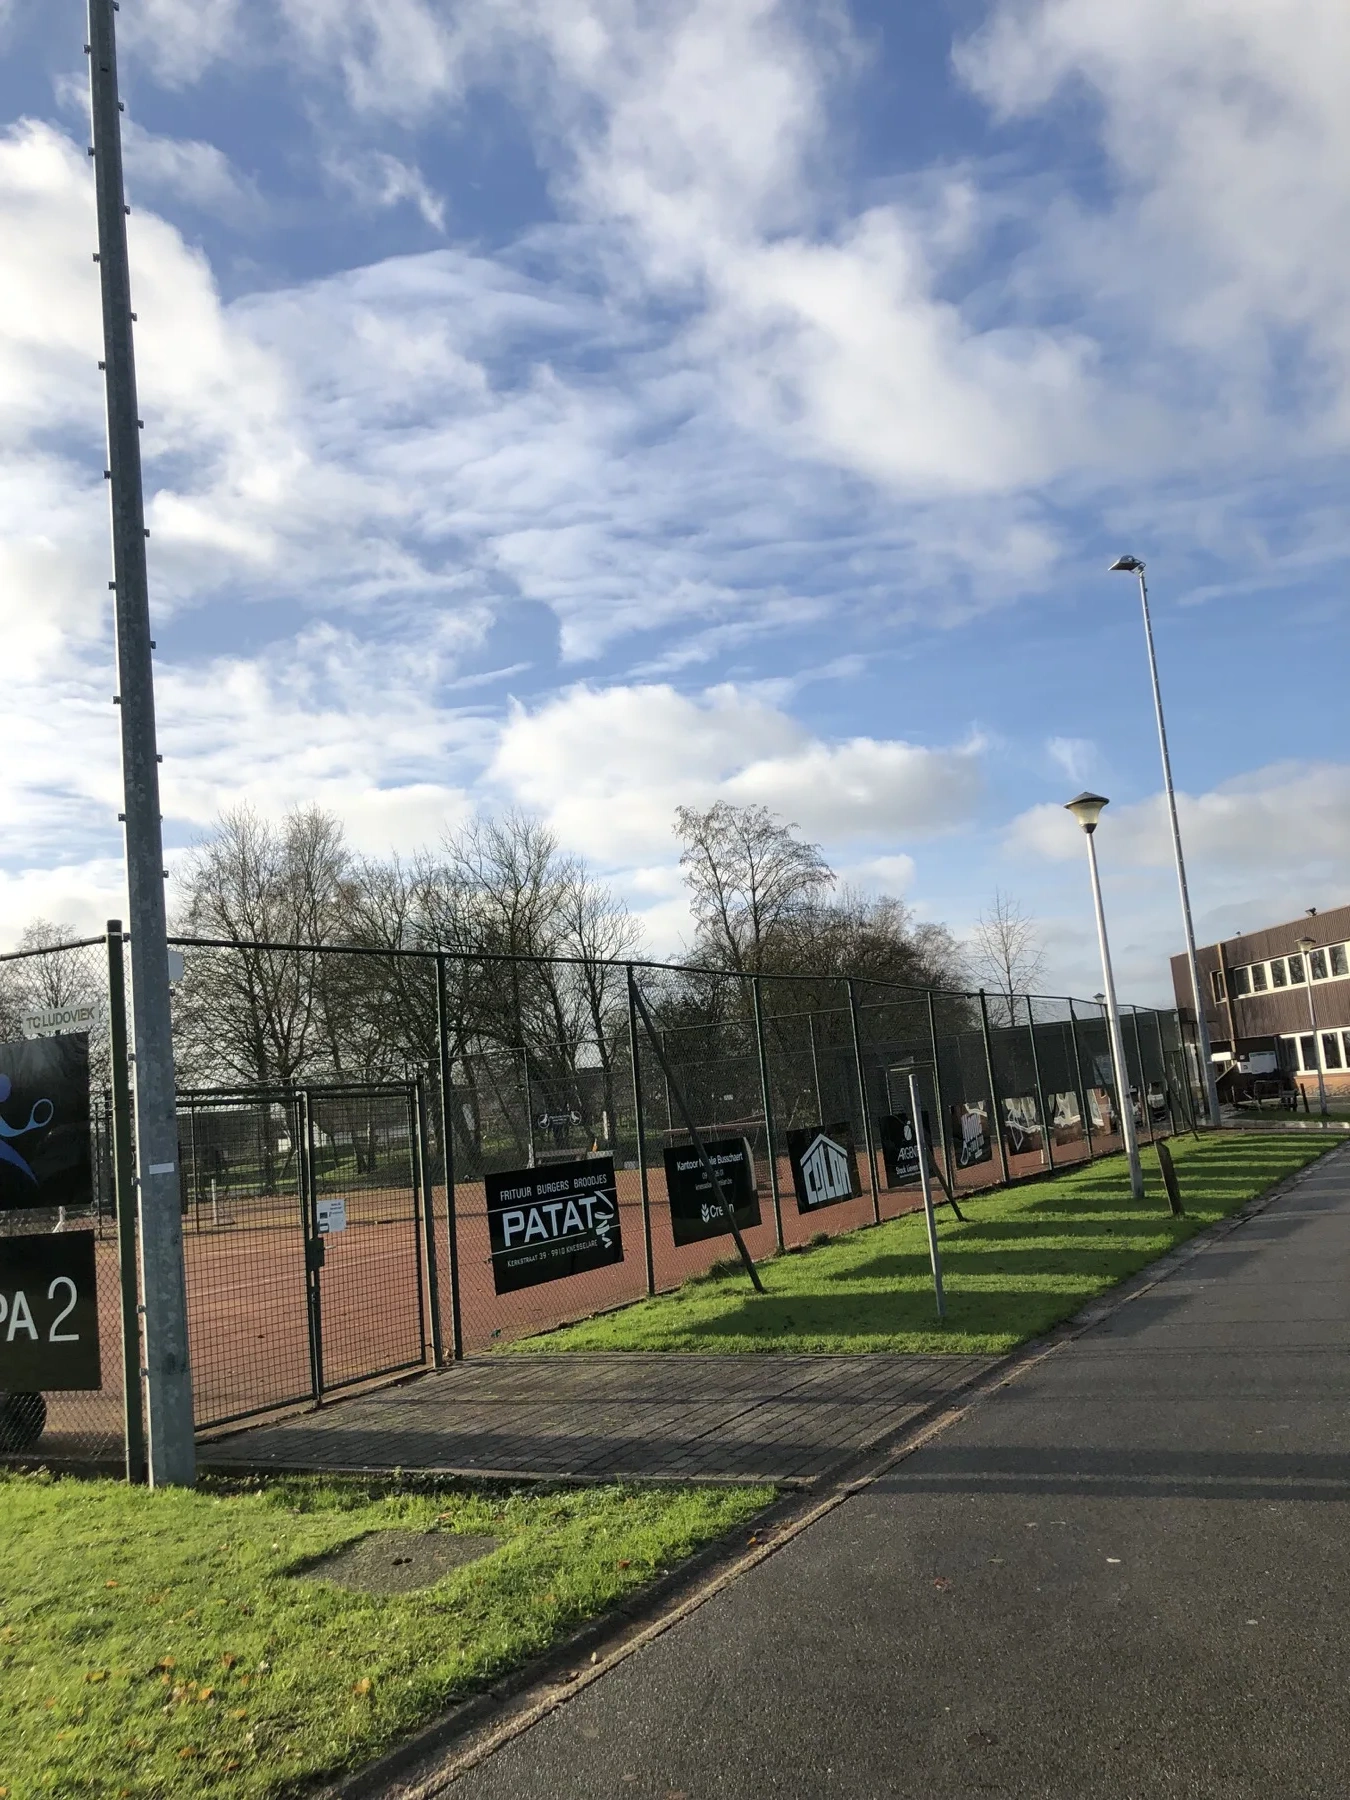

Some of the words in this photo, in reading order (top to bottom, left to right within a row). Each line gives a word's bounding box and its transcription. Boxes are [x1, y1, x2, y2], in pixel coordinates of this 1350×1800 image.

[26, 1015, 41, 1030] TC
[42, 1006, 95, 1028] LUDOVIEK
[676, 1160, 698, 1171] Kantoor
[717, 1152, 743, 1164] Busschaert
[500, 1187, 532, 1202] FRITUUR
[536, 1180, 570, 1195] BURGERS
[573, 1174, 607, 1188] BROODJES
[502, 1195, 598, 1247] PATAT
[709, 1203, 735, 1218] Cren
[539, 1251, 547, 1260] 39
[551, 1247, 566, 1257] 9910
[565, 1239, 599, 1255] KNESSELARE
[47, 1276, 80, 1342] 2
